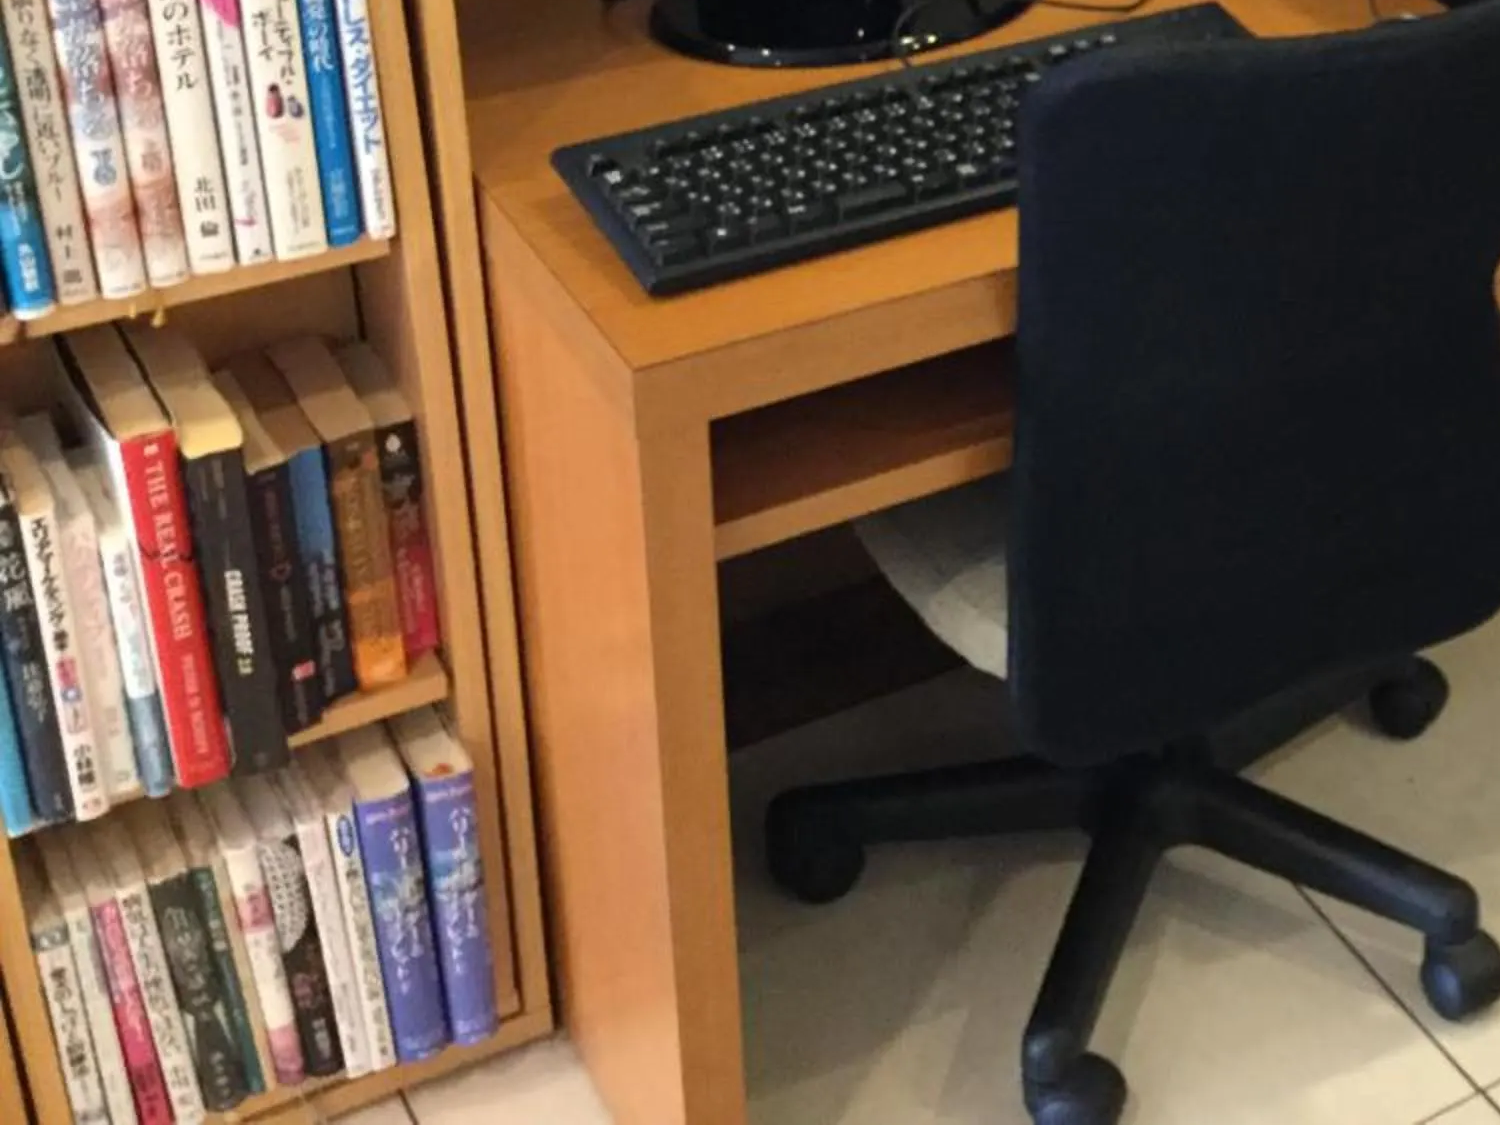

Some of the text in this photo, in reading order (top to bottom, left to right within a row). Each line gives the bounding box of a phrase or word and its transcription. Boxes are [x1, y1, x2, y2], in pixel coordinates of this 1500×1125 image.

[144, 460, 193, 642] THE REAL CRASH
[231, 612, 255, 656] PROOF
